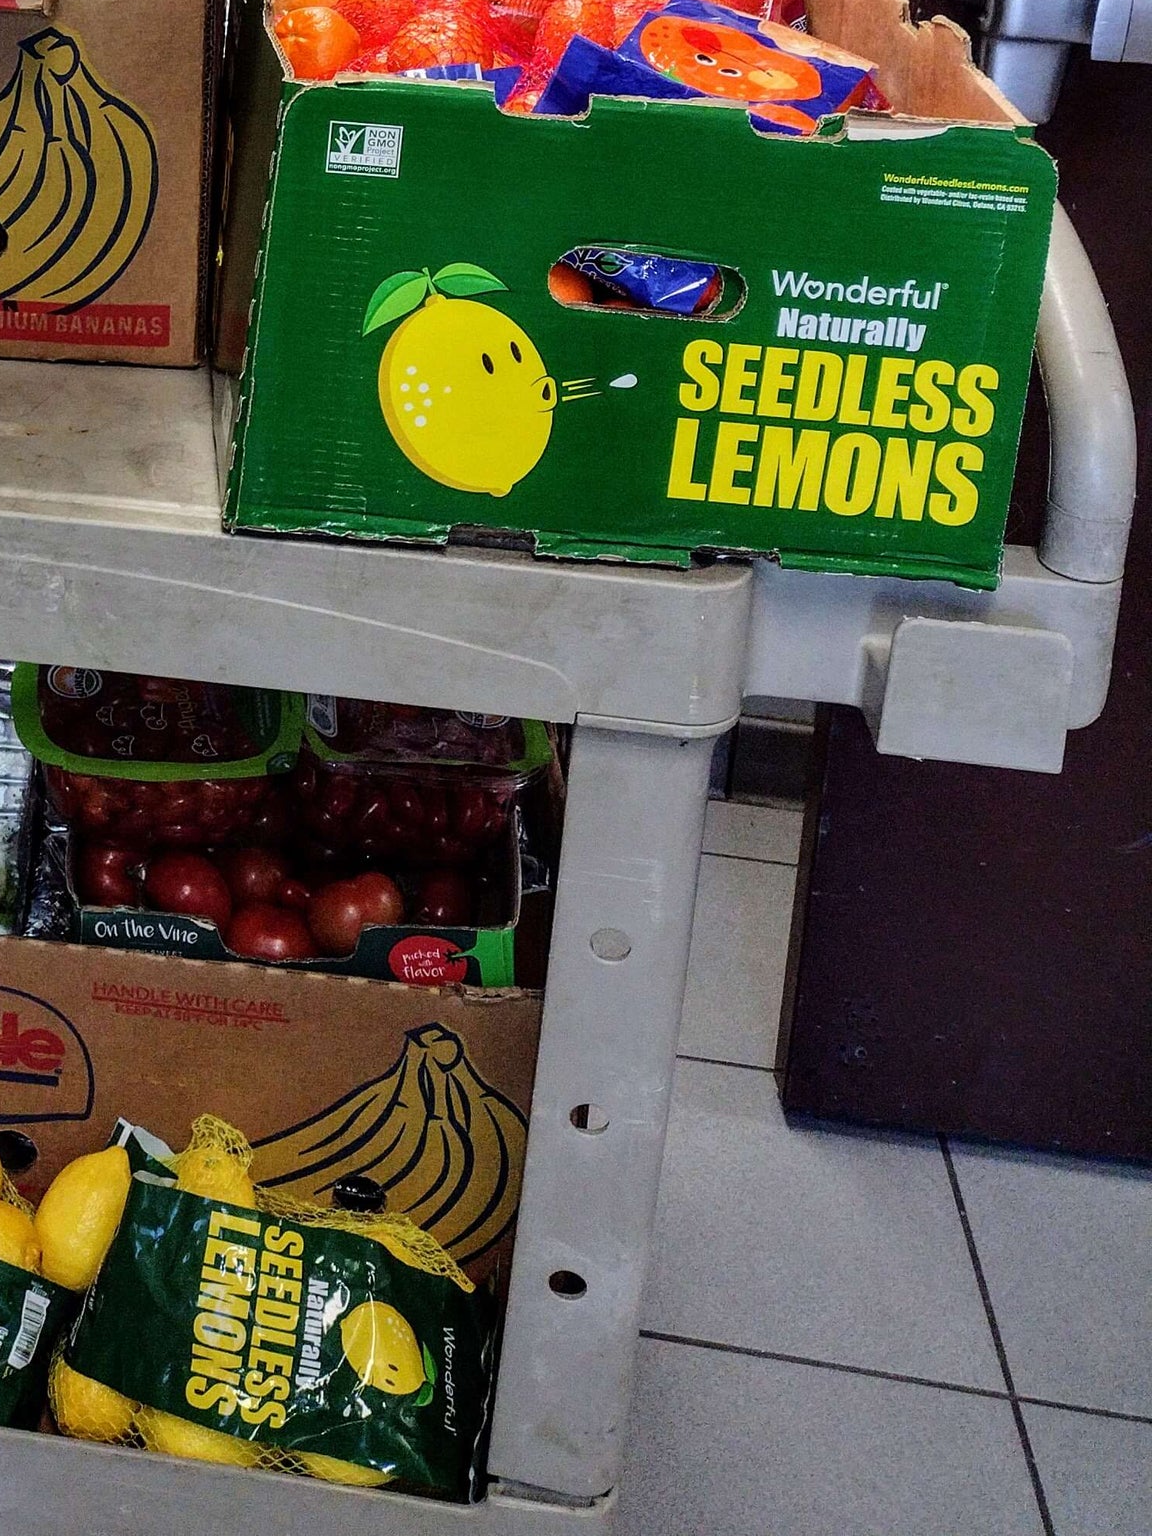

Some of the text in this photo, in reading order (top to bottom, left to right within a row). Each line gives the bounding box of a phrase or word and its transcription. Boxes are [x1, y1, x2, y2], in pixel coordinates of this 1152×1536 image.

[367, 138, 397, 149] GMO
[368, 129, 397, 139] NON
[333, 153, 394, 165] VERIFIED
[366, 146, 395, 156] Project
[328, 163, 397, 177] nongmoproject.org
[883, 173, 1029, 193] WonderfulSeedlessLemons.com
[913, 196, 921, 205] by
[772, 269, 941, 311] Wonderful
[55, 313, 163, 336] BANANAS
[776, 308, 927, 351] Naturally
[679, 339, 999, 438] SEEDLESS
[667, 417, 984, 527] LEMONS
[94, 919, 199, 944] On the Vine
[401, 964, 447, 979] flavor
[93, 981, 285, 1016] HANDLE WITH CARE
[185, 1210, 262, 1415] LEMONS
[239, 1223, 305, 1429] SEEDLESS
[295, 1276, 329, 1388] Naturally
[443, 1326, 456, 1431] Wonderful
